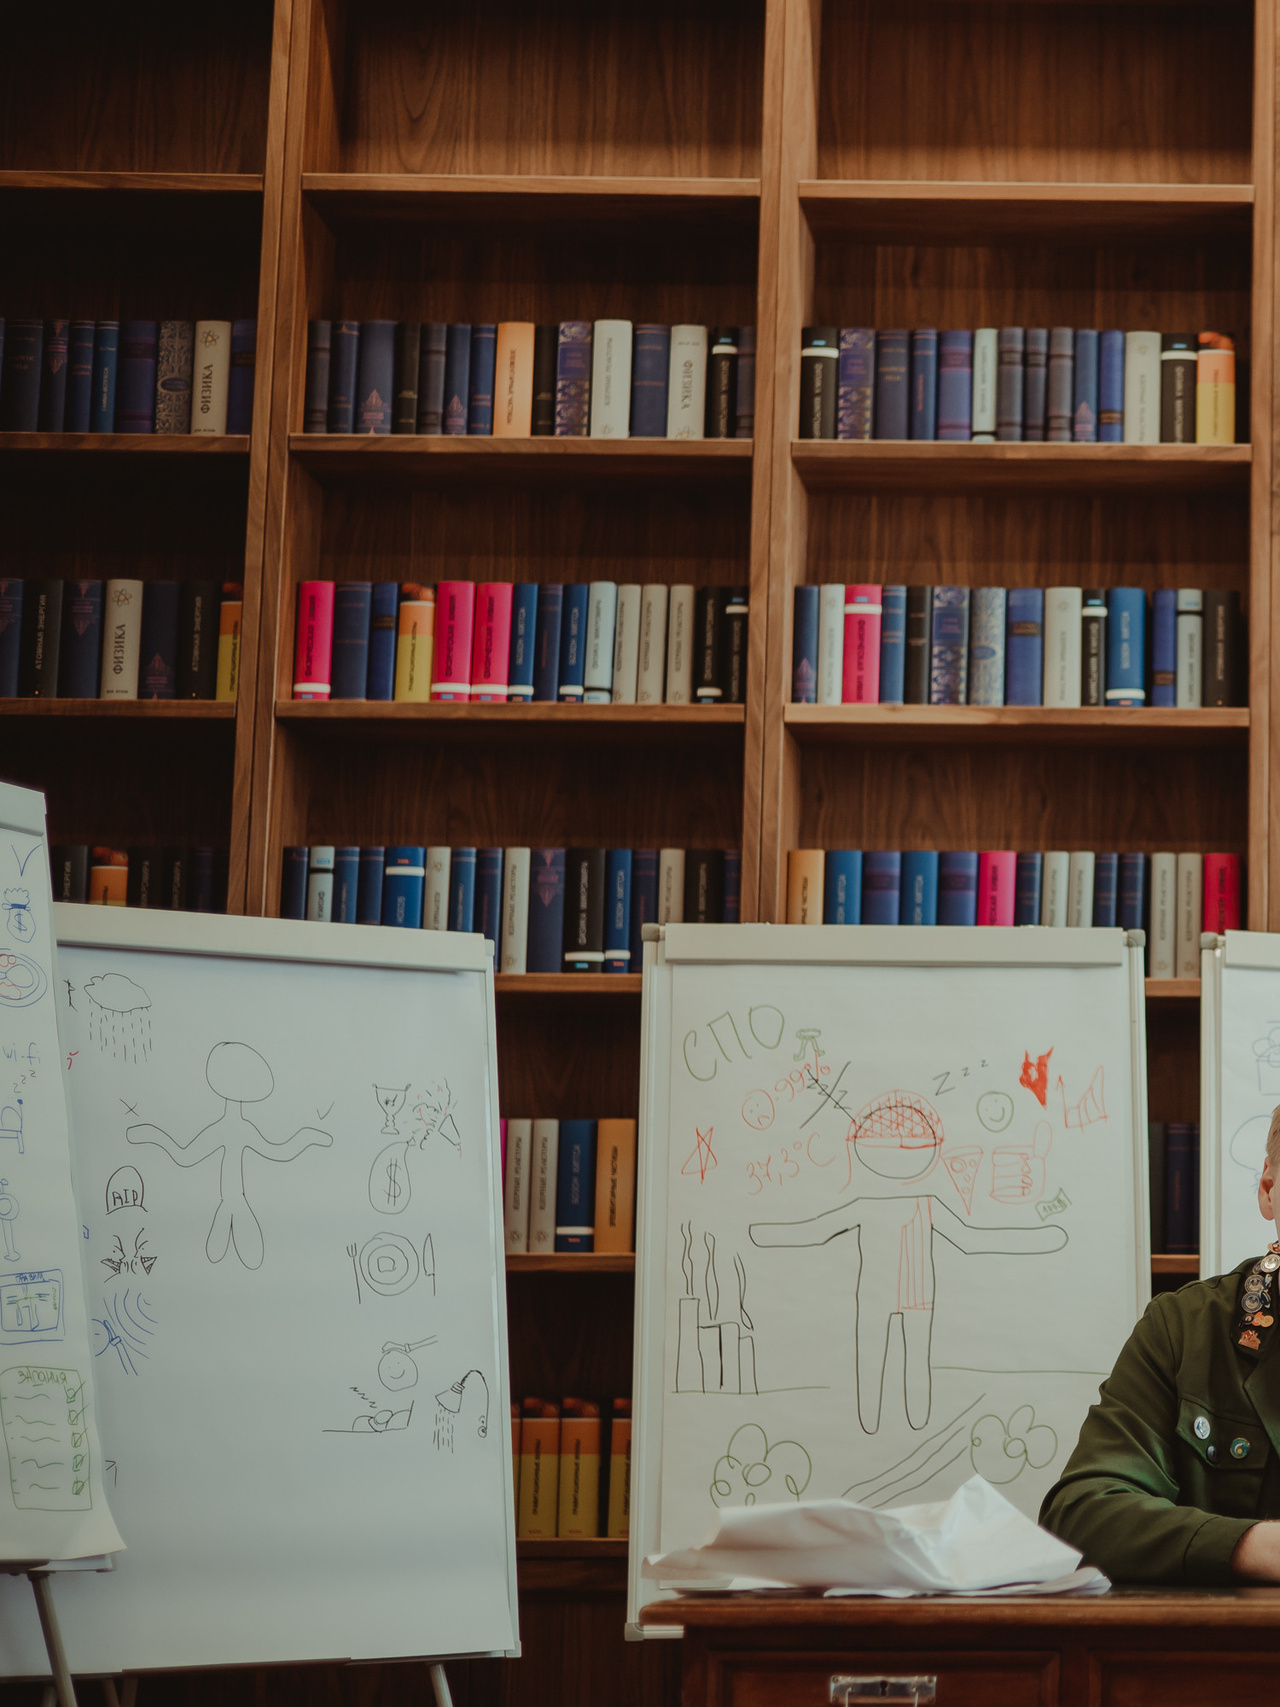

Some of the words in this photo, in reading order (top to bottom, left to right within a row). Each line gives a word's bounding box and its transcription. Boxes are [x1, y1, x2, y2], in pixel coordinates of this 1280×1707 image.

[199, 363, 214, 415] ФИЗИКА
[681, 358, 695, 411] ФИЗИКА
[37, 594, 47, 629] ЭНЕРГИЯ
[193, 595, 203, 630] ЭНЕРГИЯ
[35, 630, 43, 671] АТОМНАЯ
[112, 622, 127, 676] ФИЗИКА
[191, 631, 200, 673] АТОМНАЯ
[62, 860, 72, 899] ЭНЕРГИЯ
[683, 1004, 785, 1082] СПО
